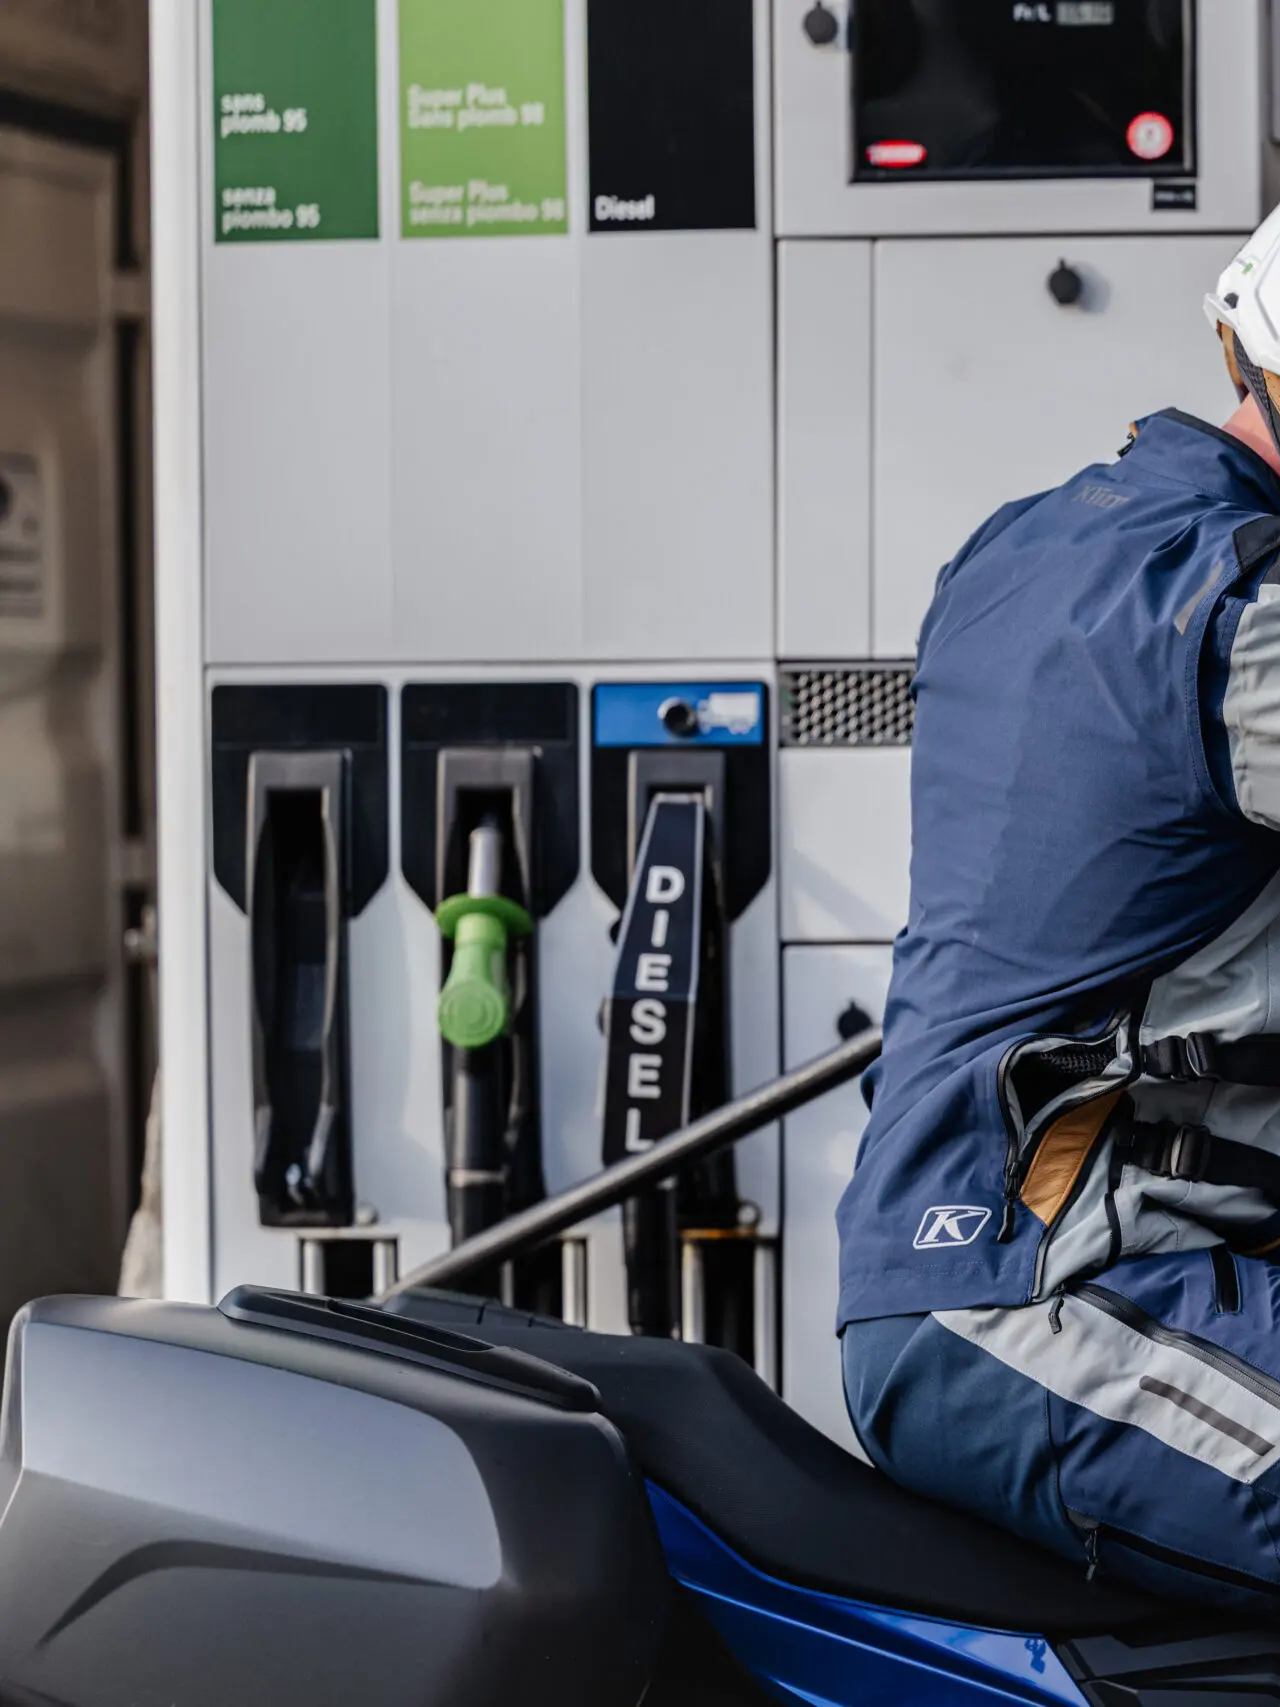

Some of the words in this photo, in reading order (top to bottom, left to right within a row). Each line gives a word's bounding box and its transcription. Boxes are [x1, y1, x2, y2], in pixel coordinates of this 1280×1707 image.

[467, 83, 506, 106] Plus
[221, 109, 281, 138] plomb
[283, 108, 307, 132] 95
[222, 187, 276, 207] senza
[469, 181, 508, 202] Plus
[295, 203, 320, 228] 95
[595, 194, 655, 220] Diesel
[625, 865, 685, 1152] DIESEL
[918, 1210, 986, 1244] K
